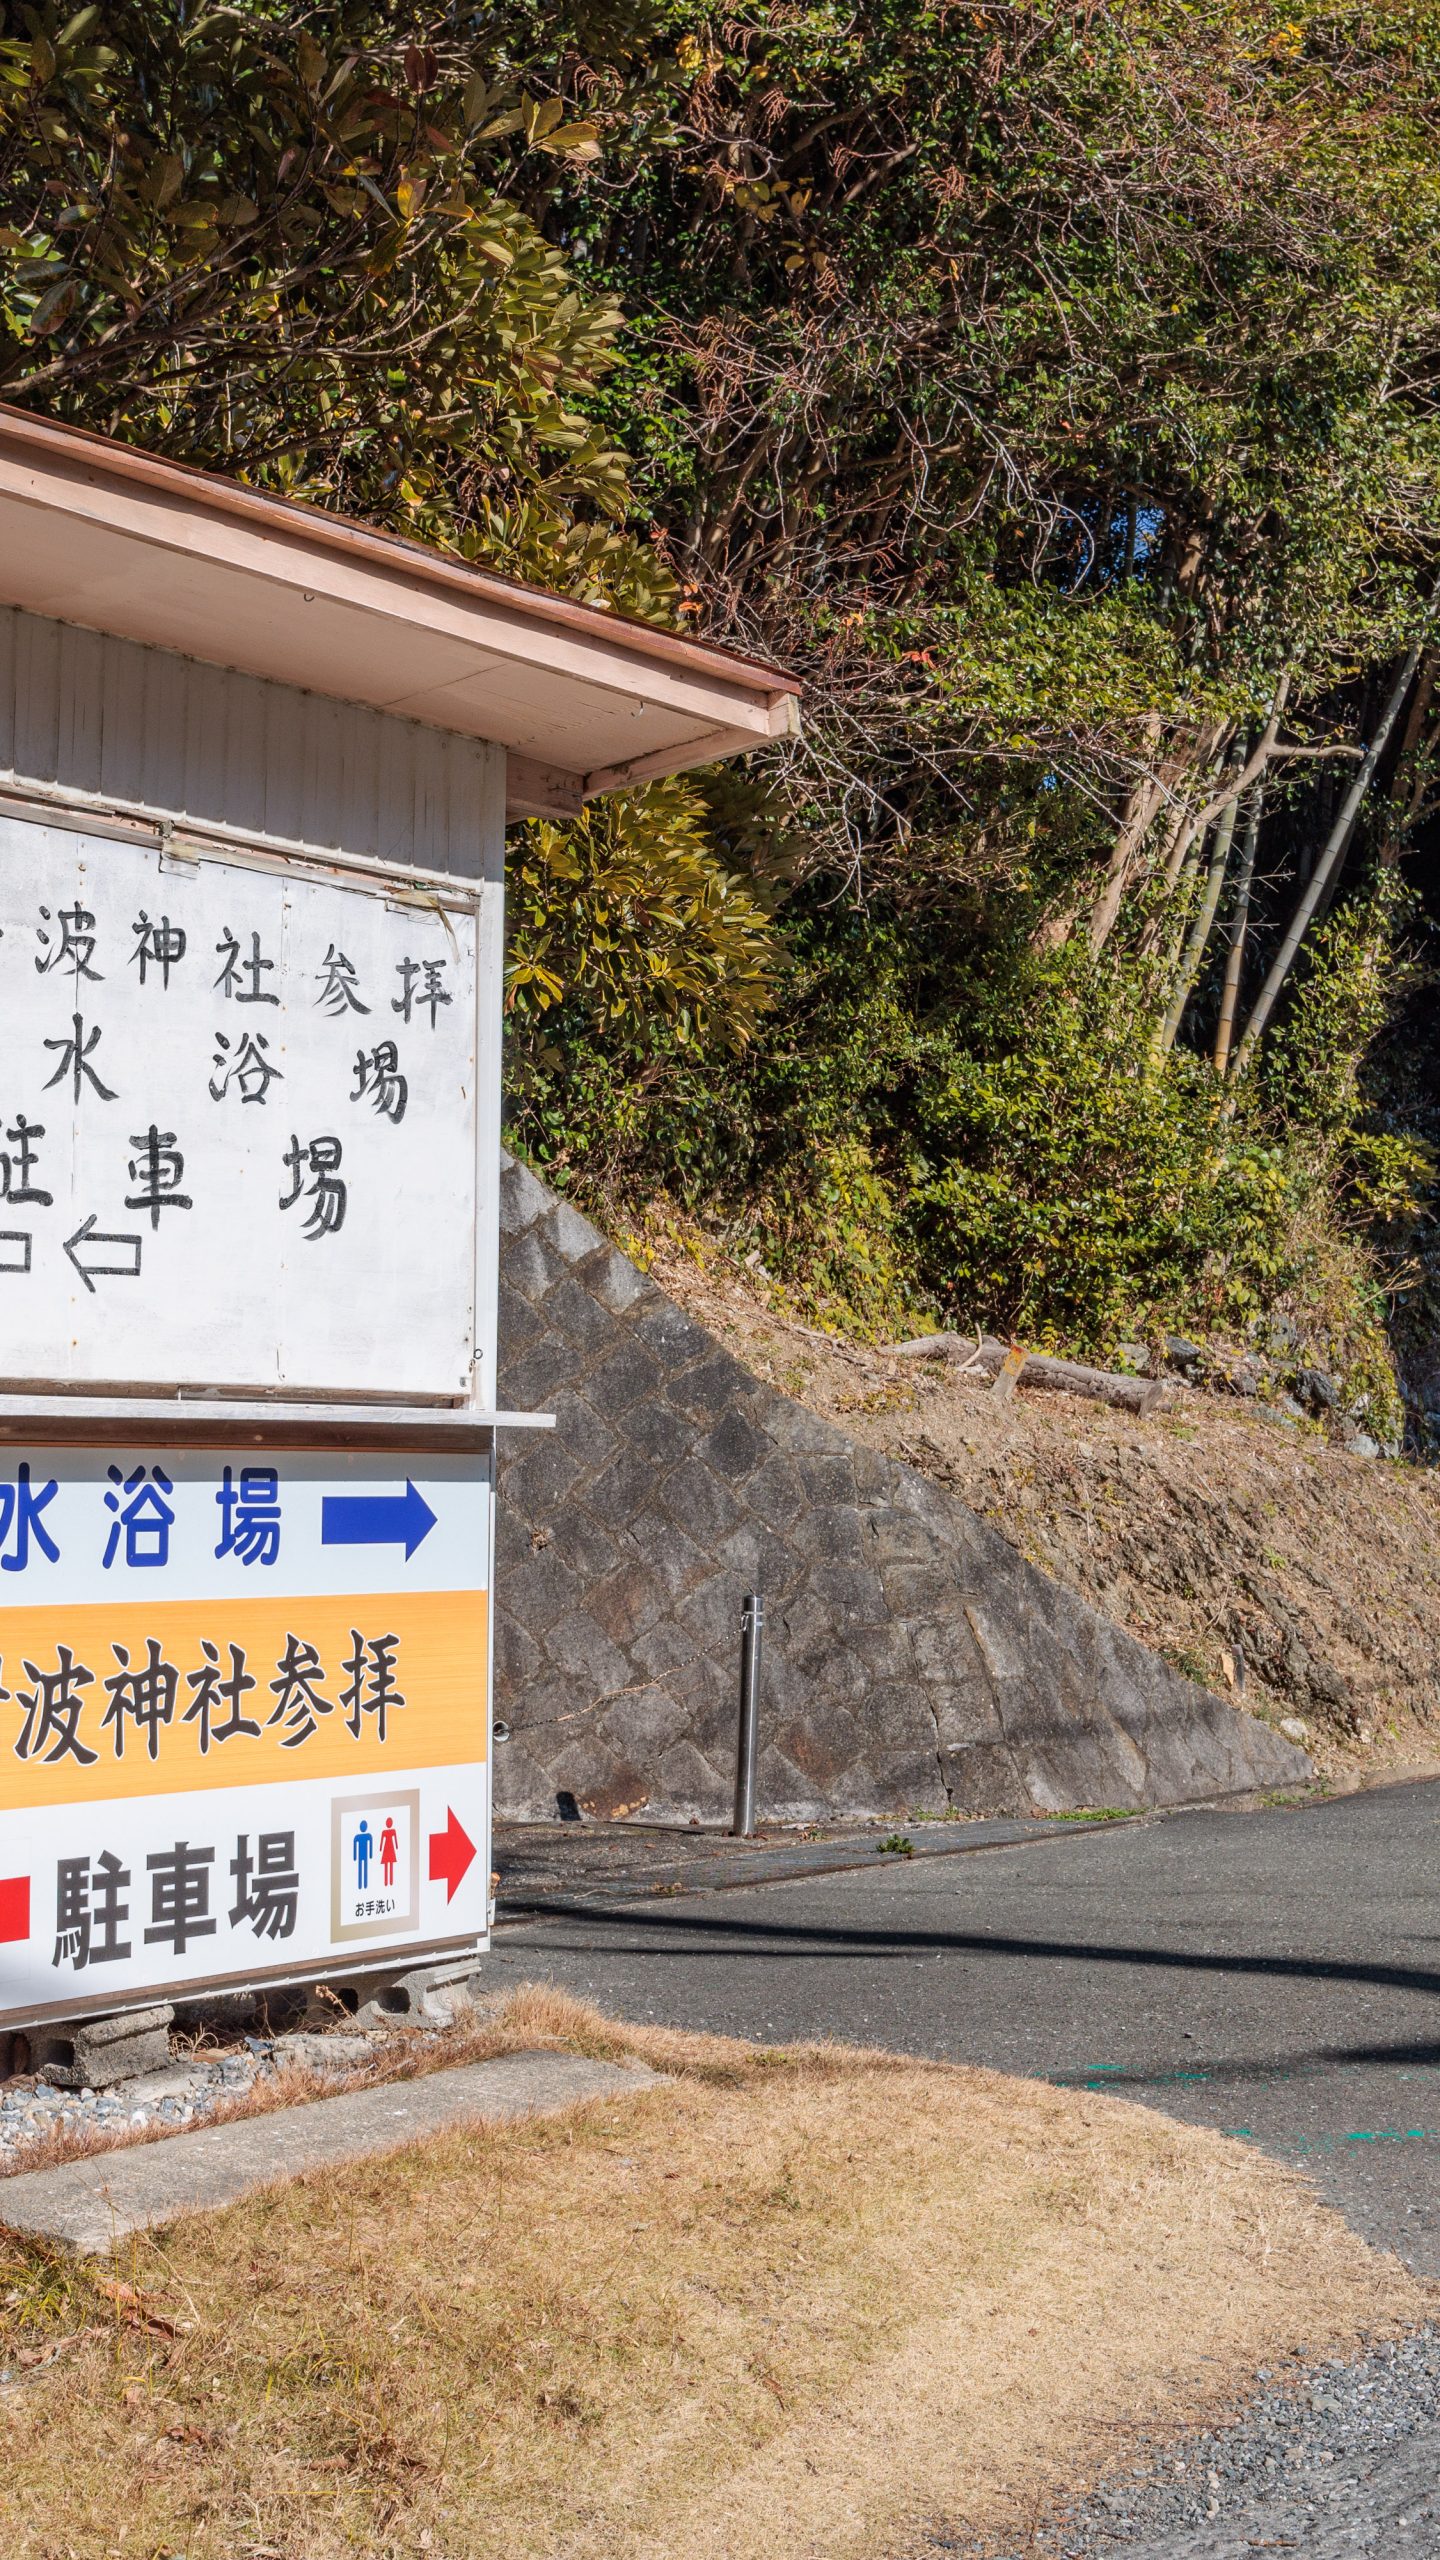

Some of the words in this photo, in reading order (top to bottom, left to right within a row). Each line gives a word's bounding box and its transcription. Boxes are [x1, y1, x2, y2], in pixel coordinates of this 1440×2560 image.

[0, 900, 454, 1030] 波神社参拝
[43, 1013, 409, 1124] 水浴場
[0, 1462, 281, 1572] 水浴場
[0, 1628, 405, 1765] 波神社参拝
[52, 1830, 299, 1970] 駐車場
[355, 1899, 396, 1917] お手洗い
